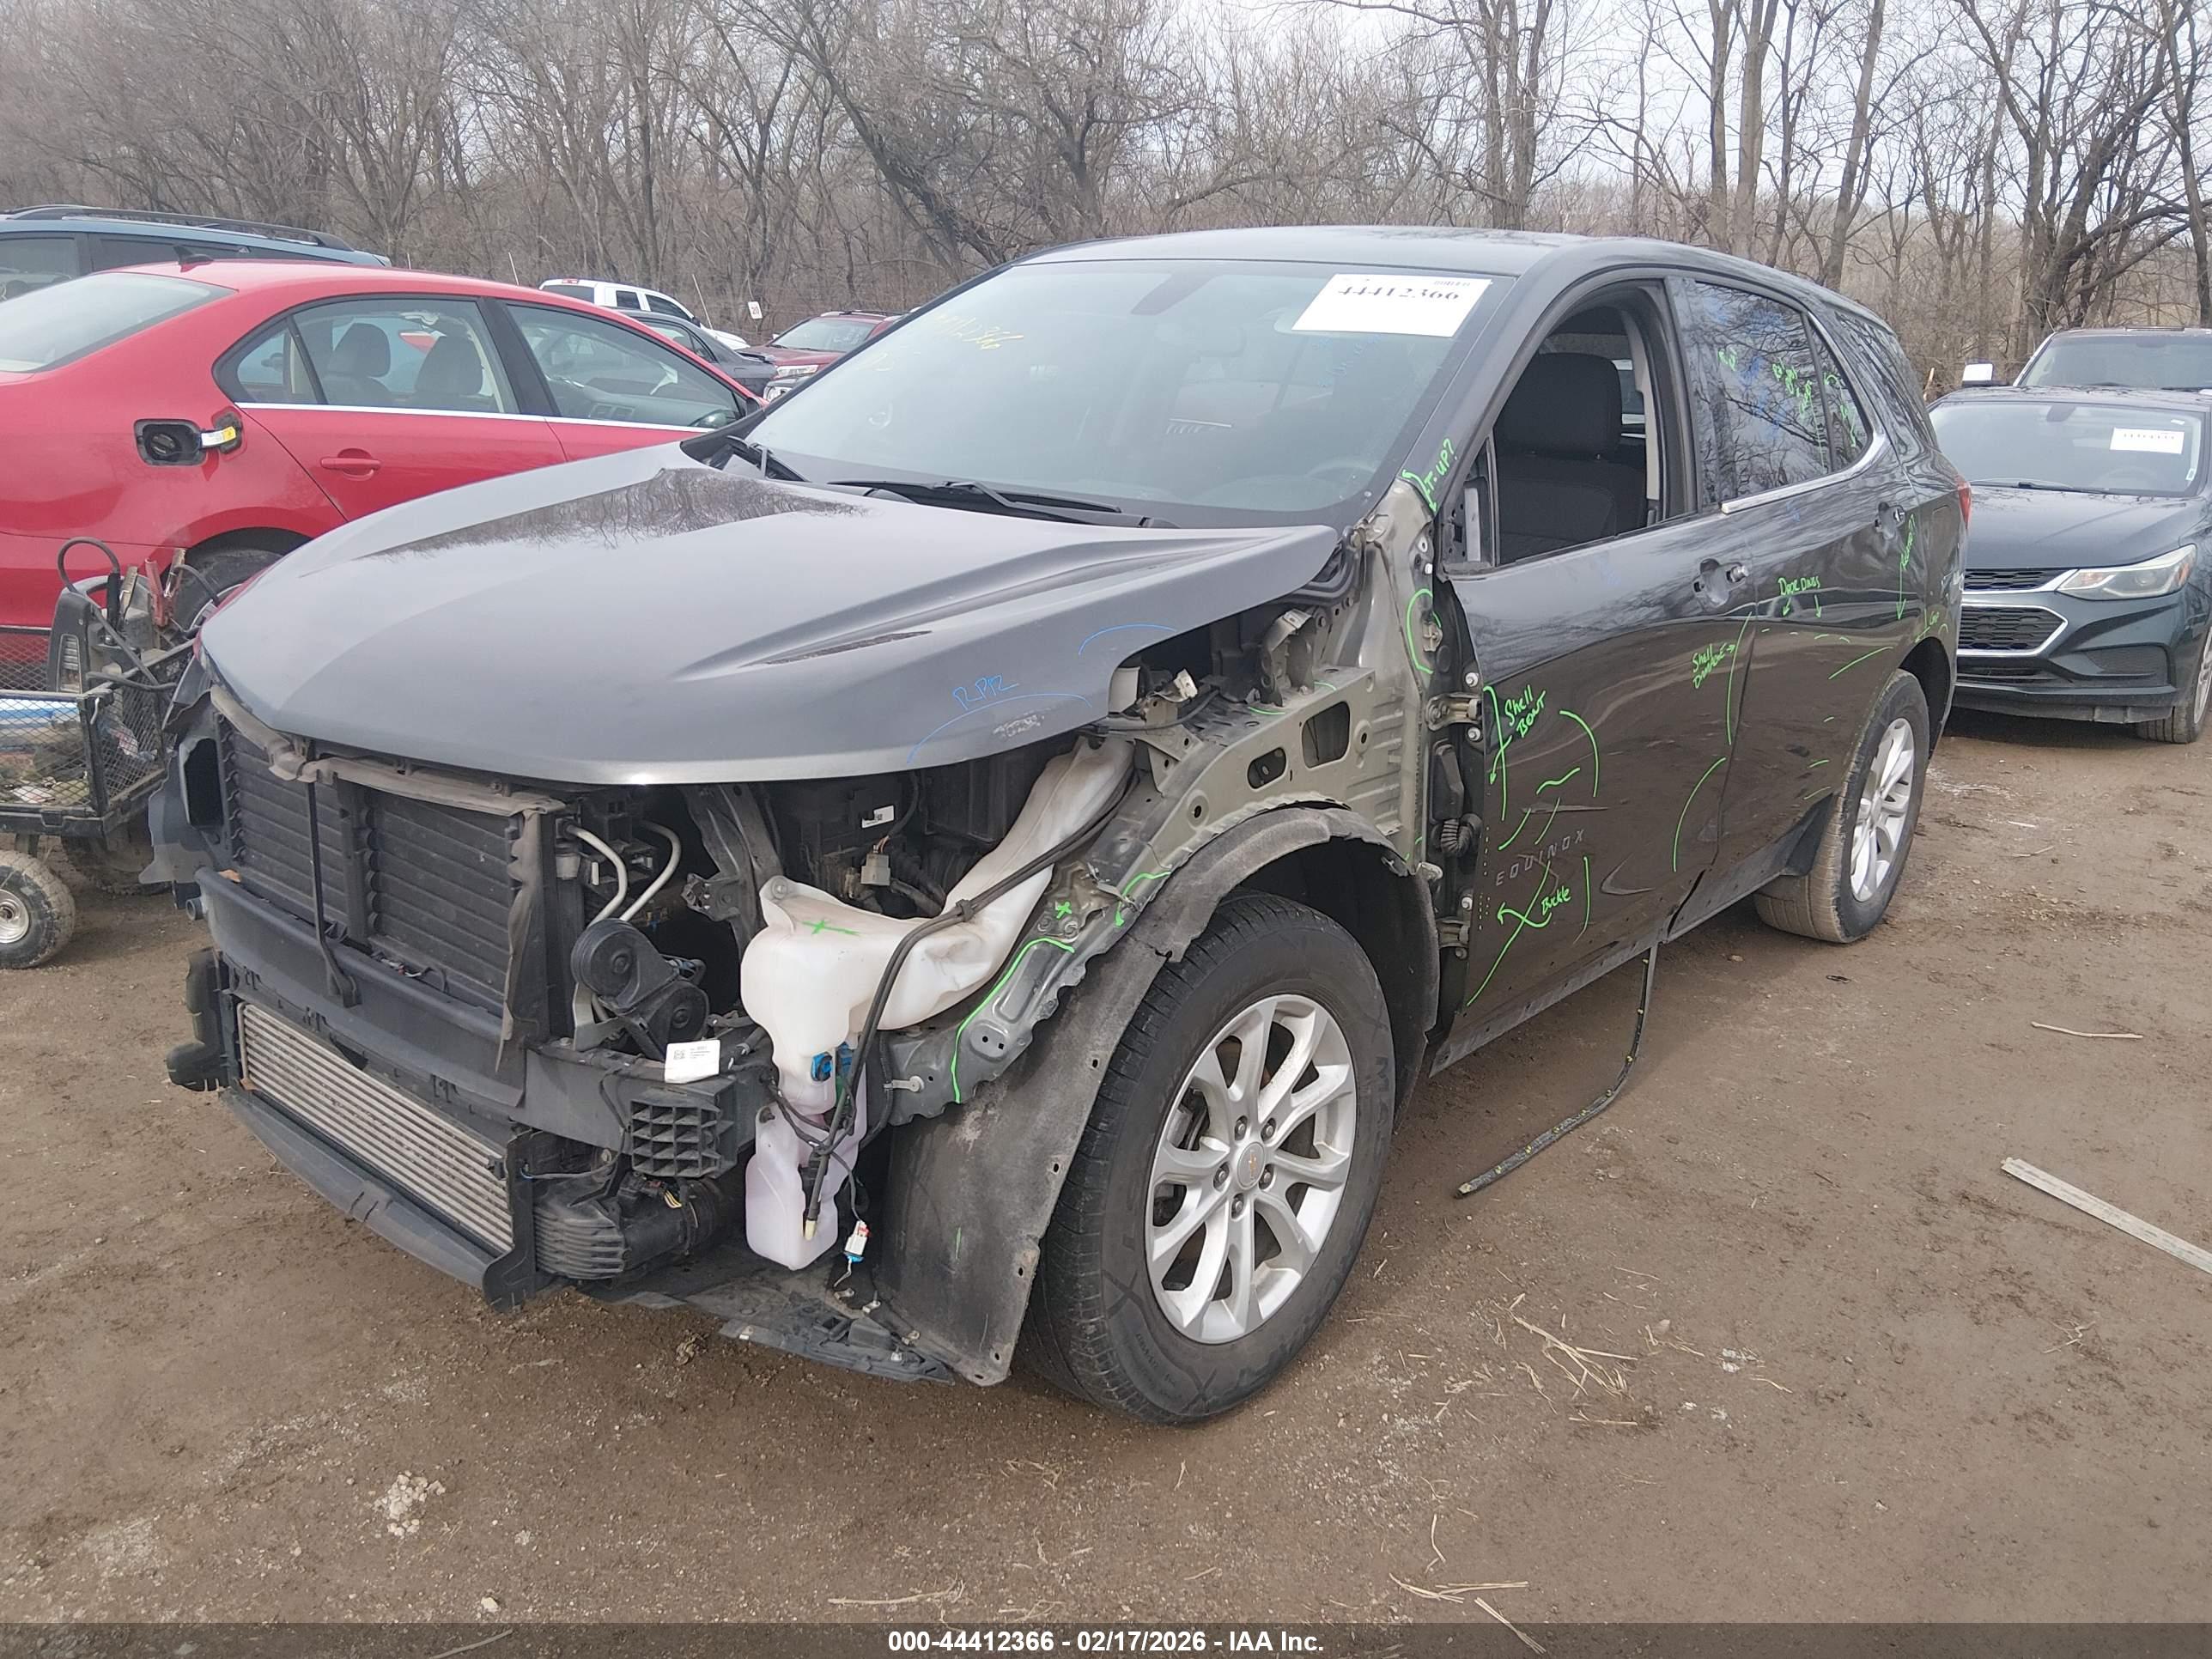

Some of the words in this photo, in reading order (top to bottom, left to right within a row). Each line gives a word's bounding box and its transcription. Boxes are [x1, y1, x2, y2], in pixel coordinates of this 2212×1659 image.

[1338, 285, 1460, 301] 44412366
[1504, 684, 1534, 727] Shell
[1495, 829, 1584, 887] EQUINOX
